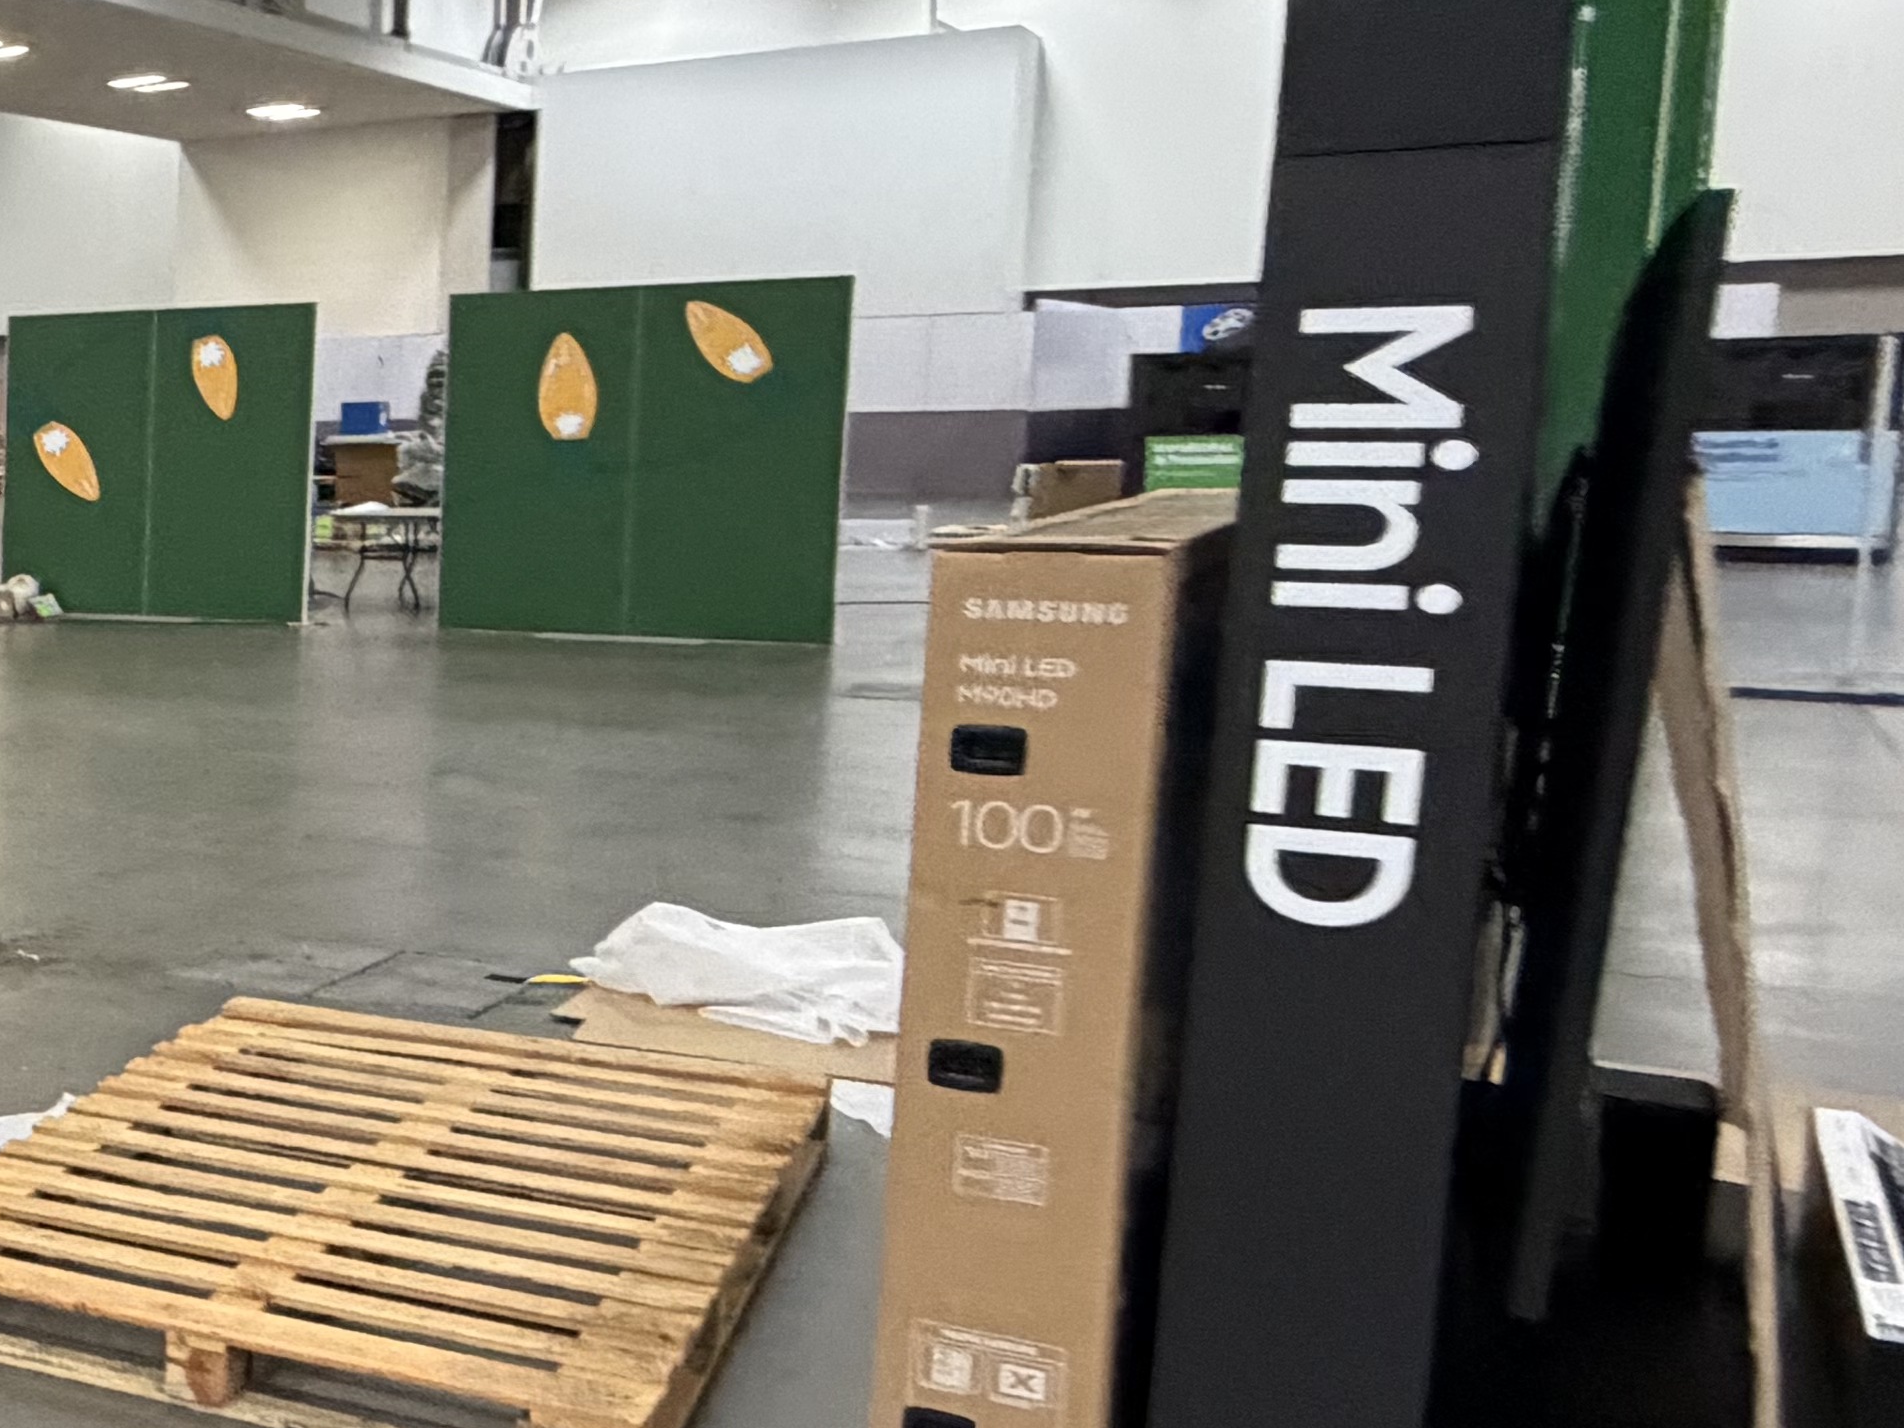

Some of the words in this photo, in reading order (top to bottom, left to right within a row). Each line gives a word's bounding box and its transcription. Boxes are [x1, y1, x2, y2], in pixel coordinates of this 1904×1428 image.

[1271, 305, 1478, 615] Mini
[959, 654, 1016, 675] Mini
[1025, 657, 1080, 678] LED
[963, 597, 1129, 625] SAMSUNG
[1245, 660, 1434, 927] LED
